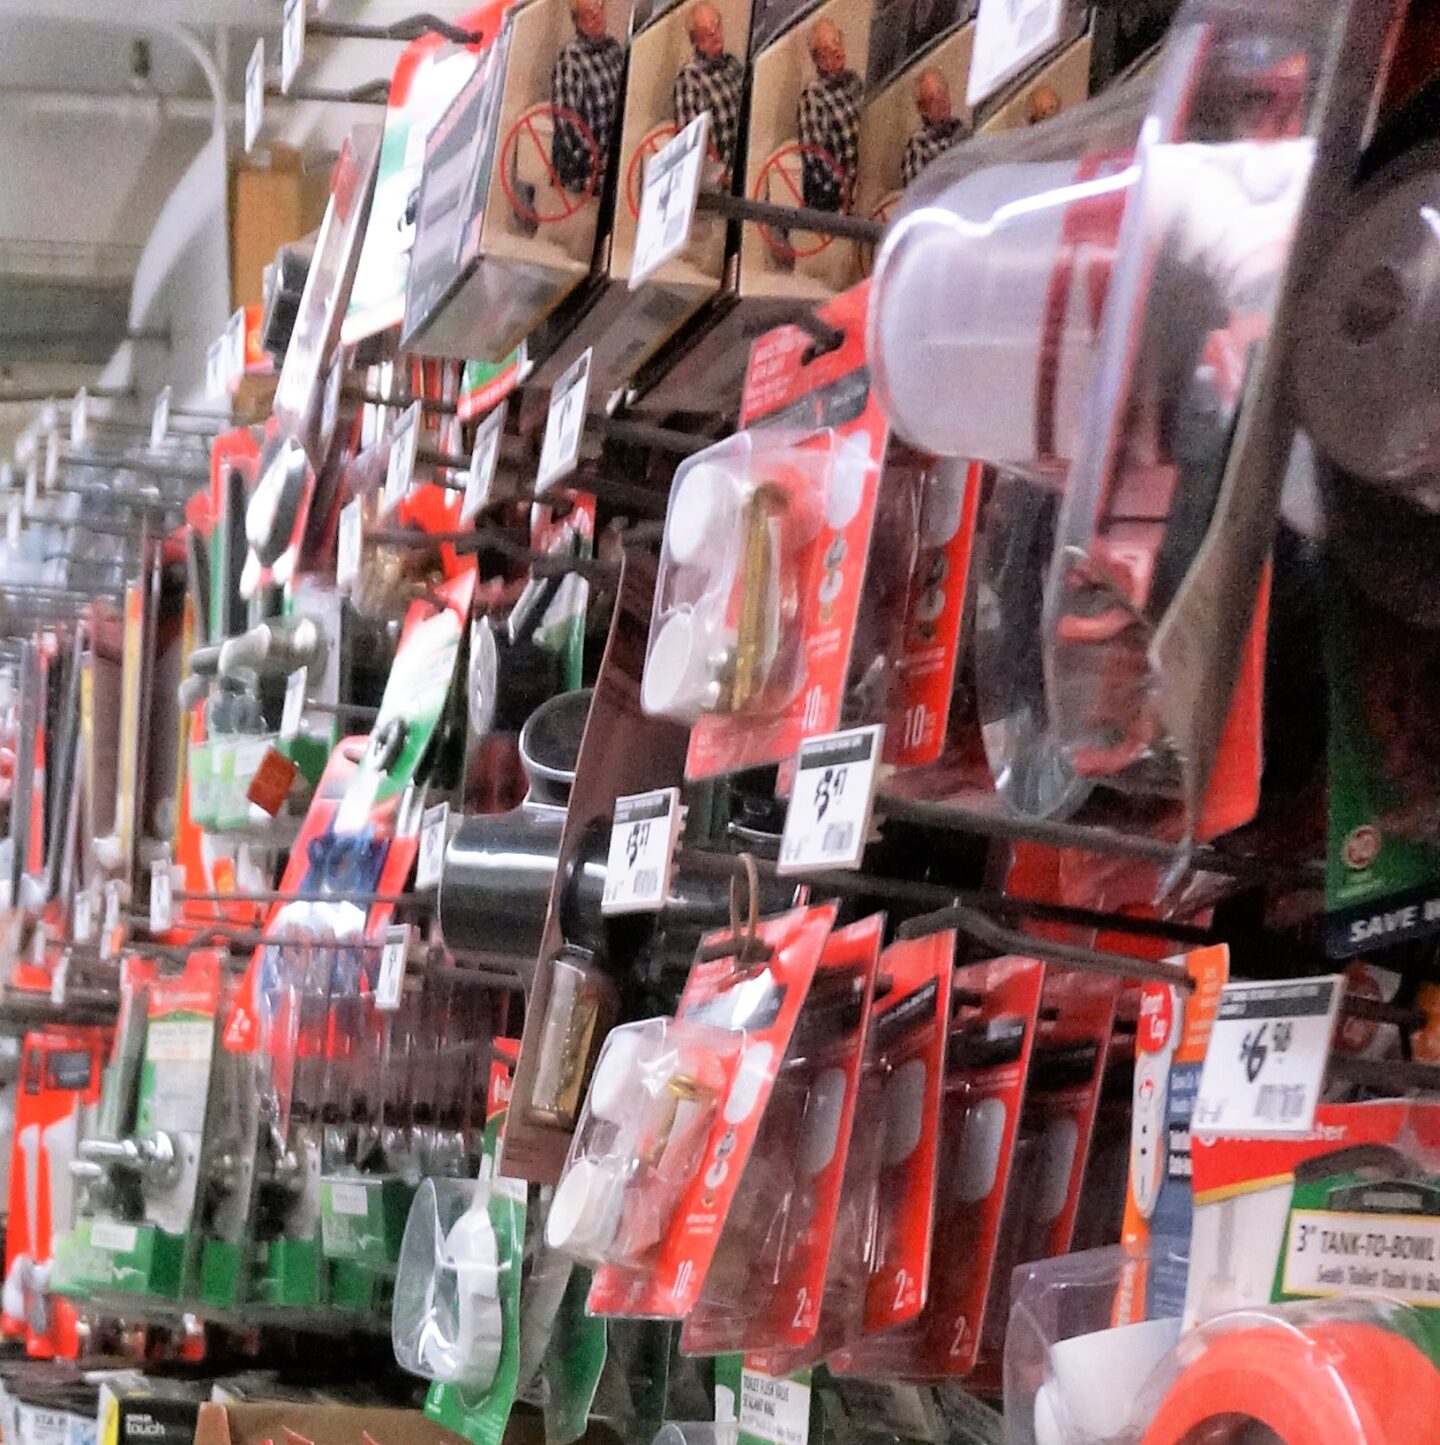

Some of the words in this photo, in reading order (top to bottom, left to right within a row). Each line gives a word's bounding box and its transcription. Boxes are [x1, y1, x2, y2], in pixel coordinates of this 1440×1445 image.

[904, 704, 924, 749] 10
[1349, 905, 1418, 943] SAVE
[672, 1260, 692, 1299] 10
[893, 1269, 906, 1310] 2
[792, 1288, 807, 1328] 2
[950, 1316, 966, 1356] 2
[126, 1422, 165, 1435] touch
